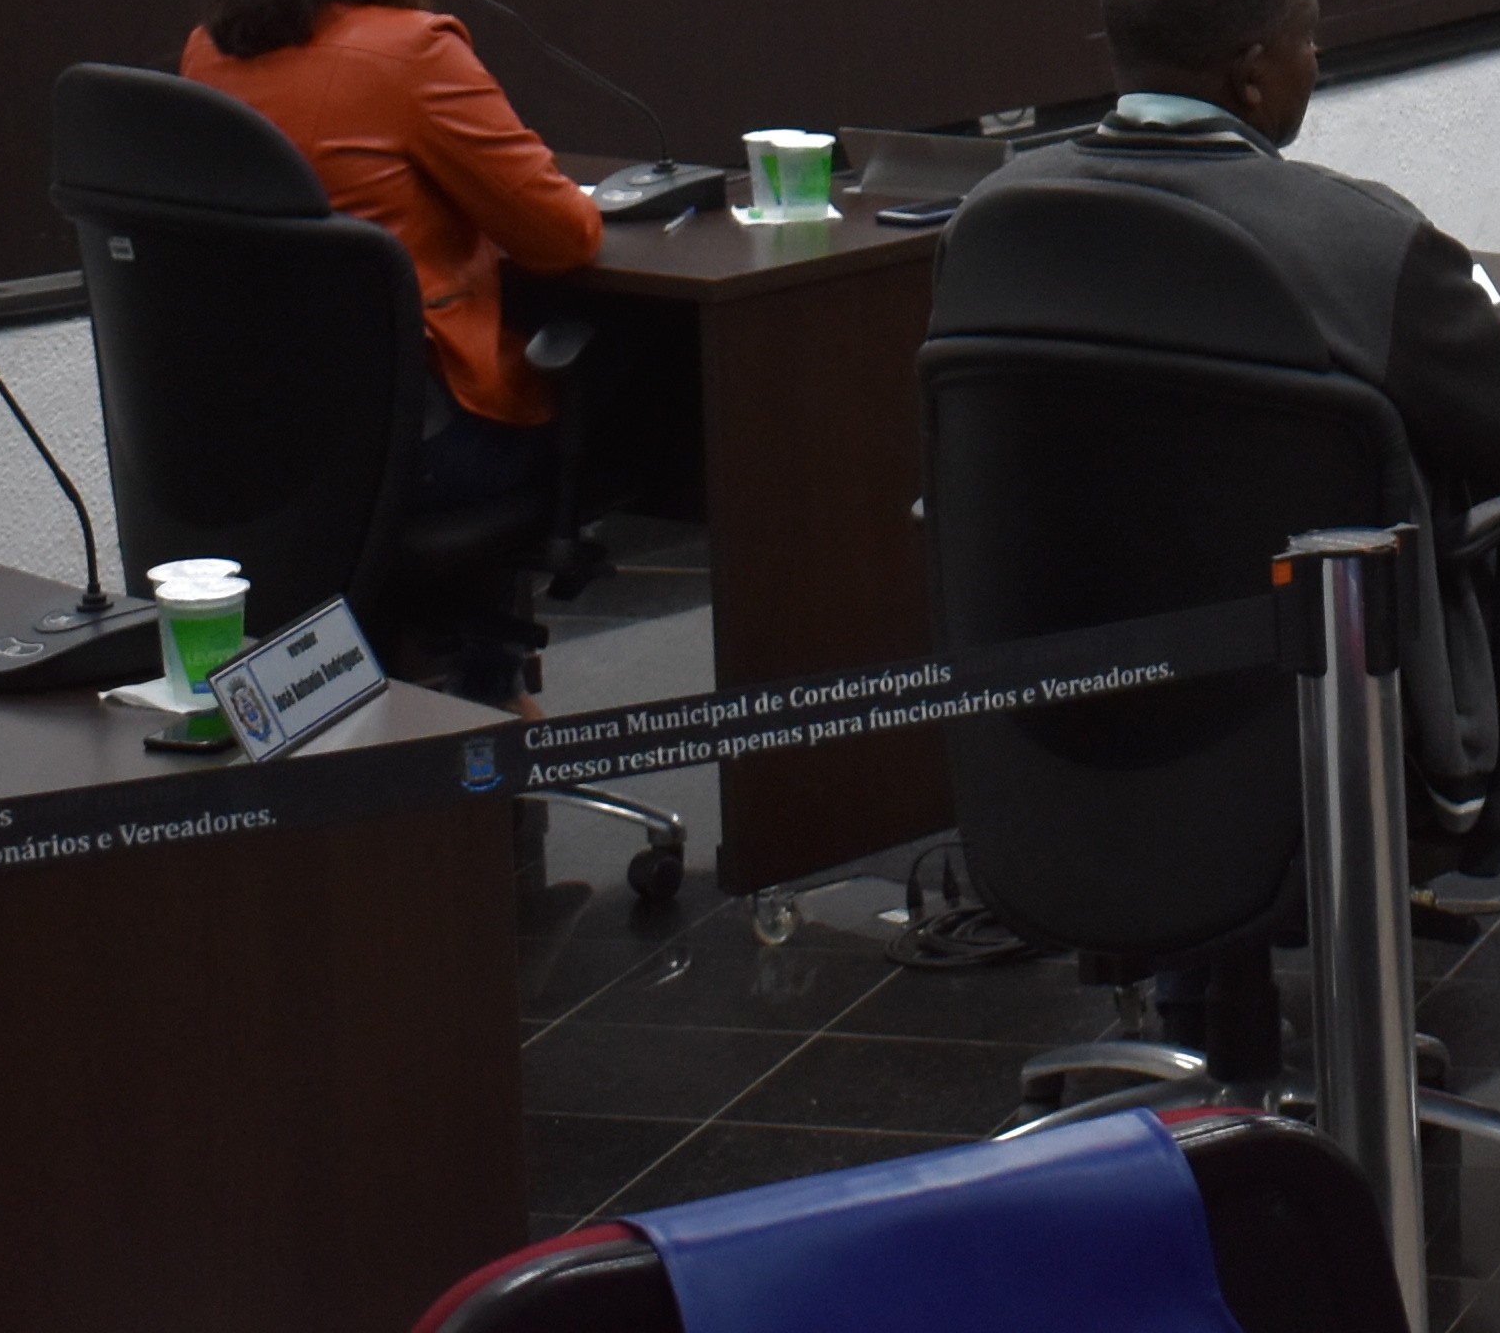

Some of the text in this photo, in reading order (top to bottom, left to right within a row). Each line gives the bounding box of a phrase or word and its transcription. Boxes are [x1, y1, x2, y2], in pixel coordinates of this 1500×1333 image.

[320, 644, 365, 682] Rodrigues
[524, 662, 952, 750] Câmara Municipal de Cordeirópolis
[527, 662, 1176, 786] Acesso restrito apenas para funcionários e Vereadores.
[97, 830, 114, 850] e
[119, 806, 279, 848] Vereadores.
